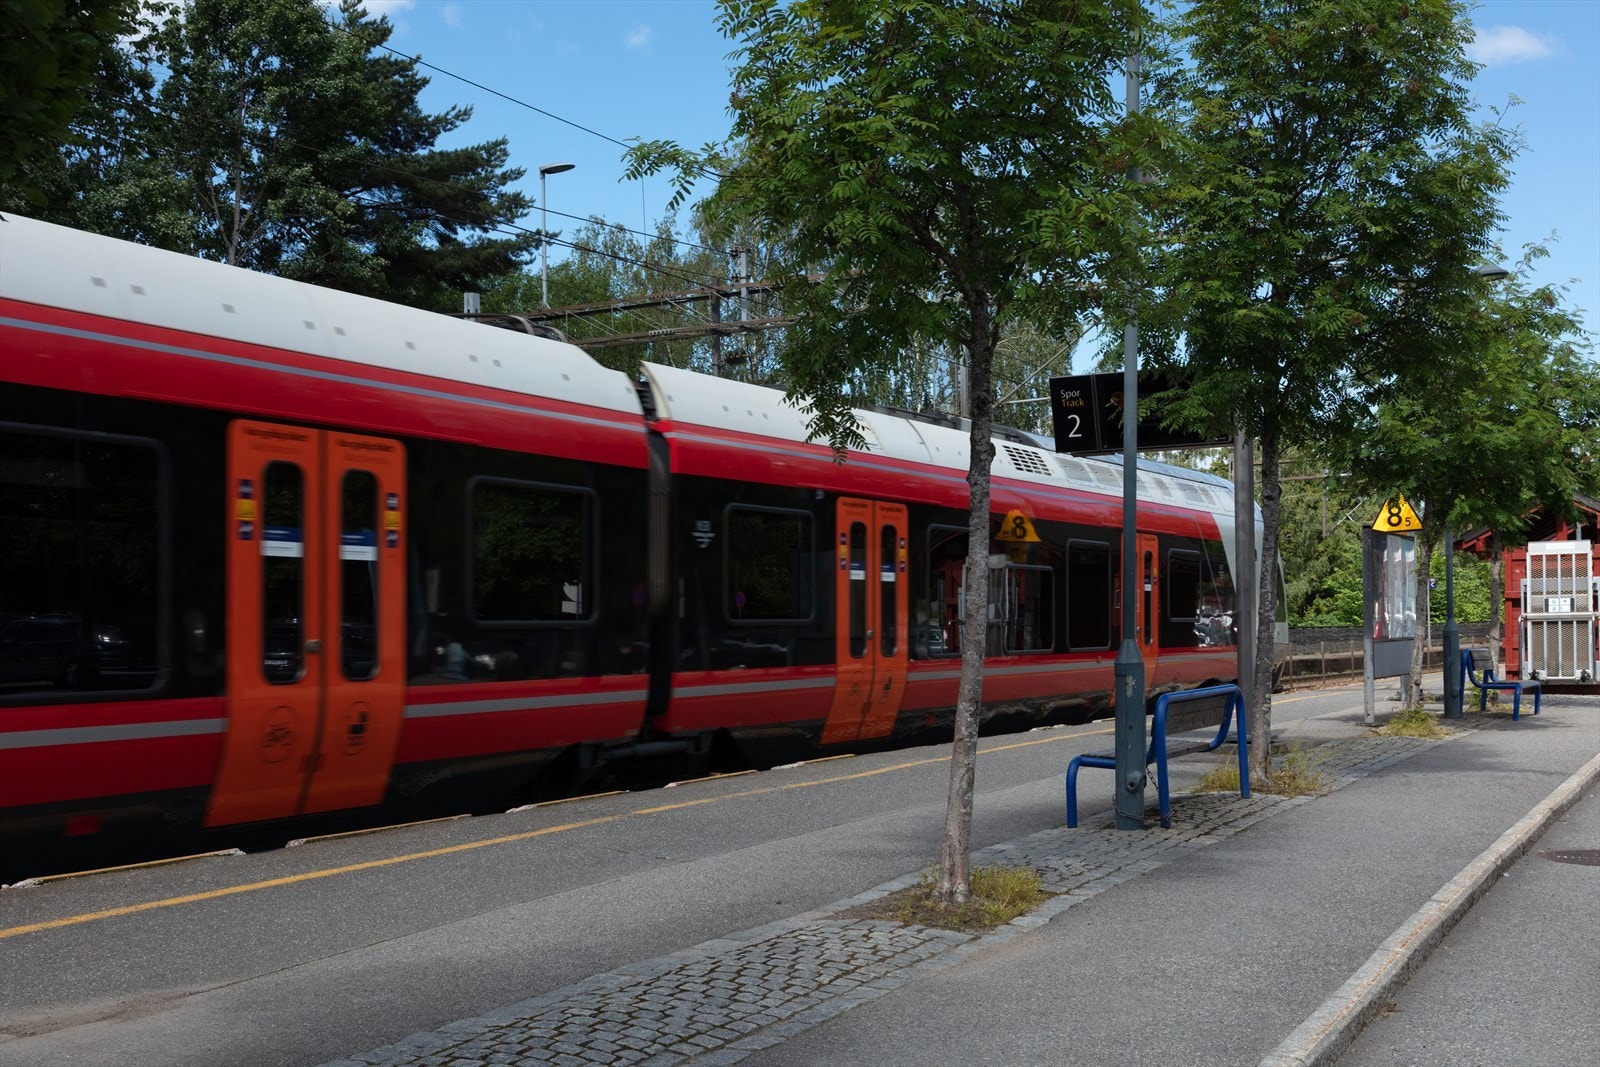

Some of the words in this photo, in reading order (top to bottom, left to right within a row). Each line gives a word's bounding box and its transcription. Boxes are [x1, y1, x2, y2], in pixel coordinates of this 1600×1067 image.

[1060, 389, 1081, 400] Spor
[1061, 397, 1085, 408] Track
[1067, 413, 1082, 438] 2
[1388, 503, 1402, 527] 8
[1405, 517, 1411, 526] 5
